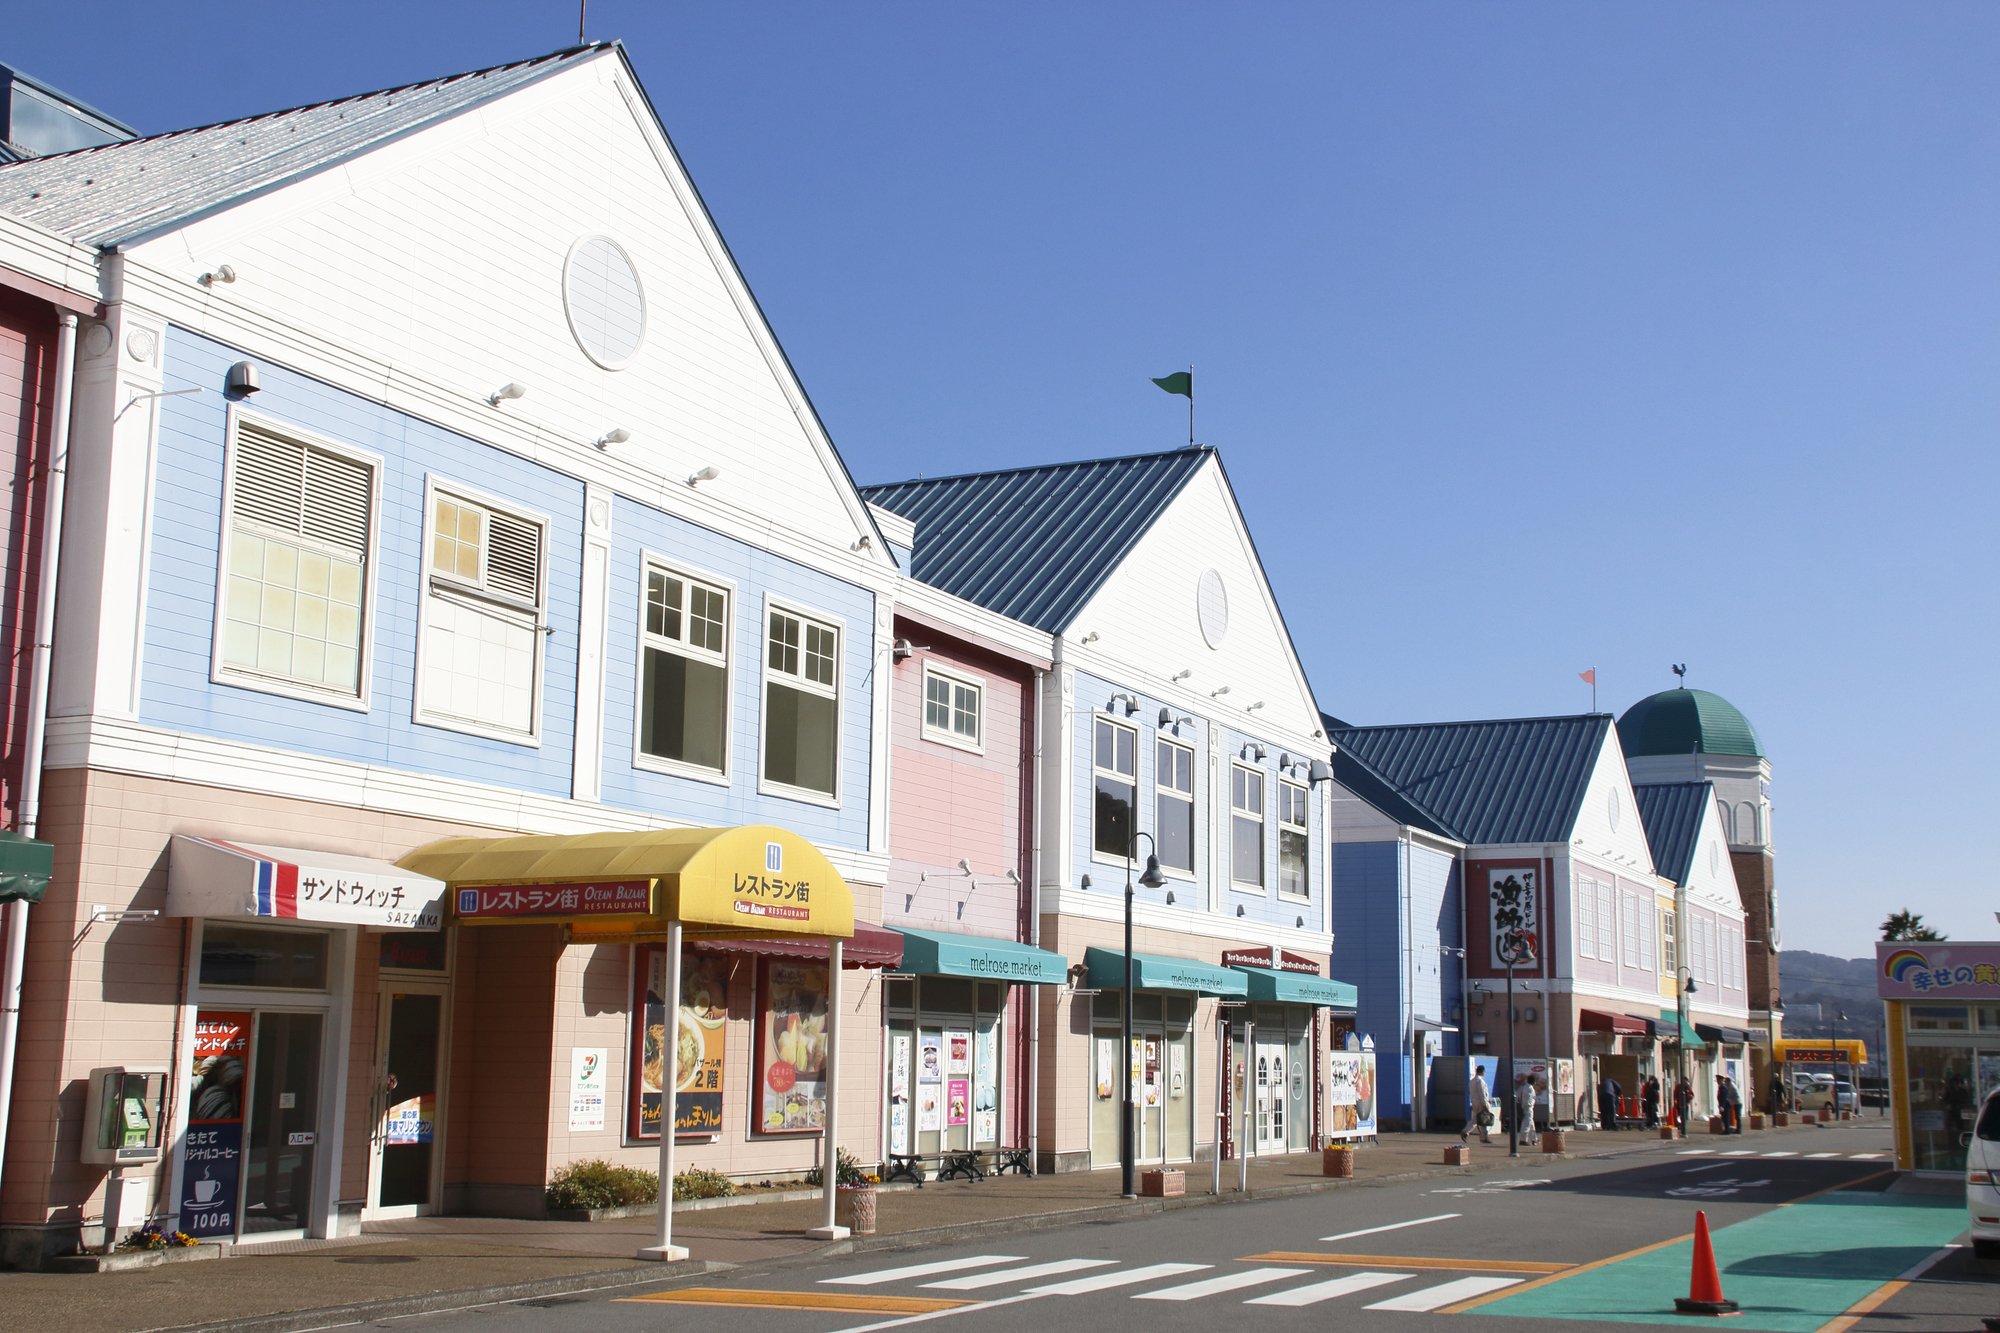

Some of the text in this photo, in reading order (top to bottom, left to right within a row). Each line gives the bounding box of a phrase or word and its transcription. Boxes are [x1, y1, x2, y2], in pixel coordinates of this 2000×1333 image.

[303, 877, 405, 909] サンドウィッチ
[584, 885, 647, 901] OCEAN BAZAAR
[734, 873, 810, 903] レストラン街
[482, 888, 579, 910] レストラン街
[584, 901, 647, 911] RESTAURANT
[735, 900, 809, 918] OCEAN BAZAAR RESTAURANT
[386, 911, 438, 927] SAZANKA
[970, 953, 1042, 977] melrose market
[1171, 971, 1224, 991] melrose market
[1912, 963, 2000, 991] 幸せの黄
[1298, 985, 1339, 1002] melrose market
[694, 1069, 719, 1089] 2階
[290, 1134, 304, 1144] 入口
[192, 1212, 231, 1229] 100円
